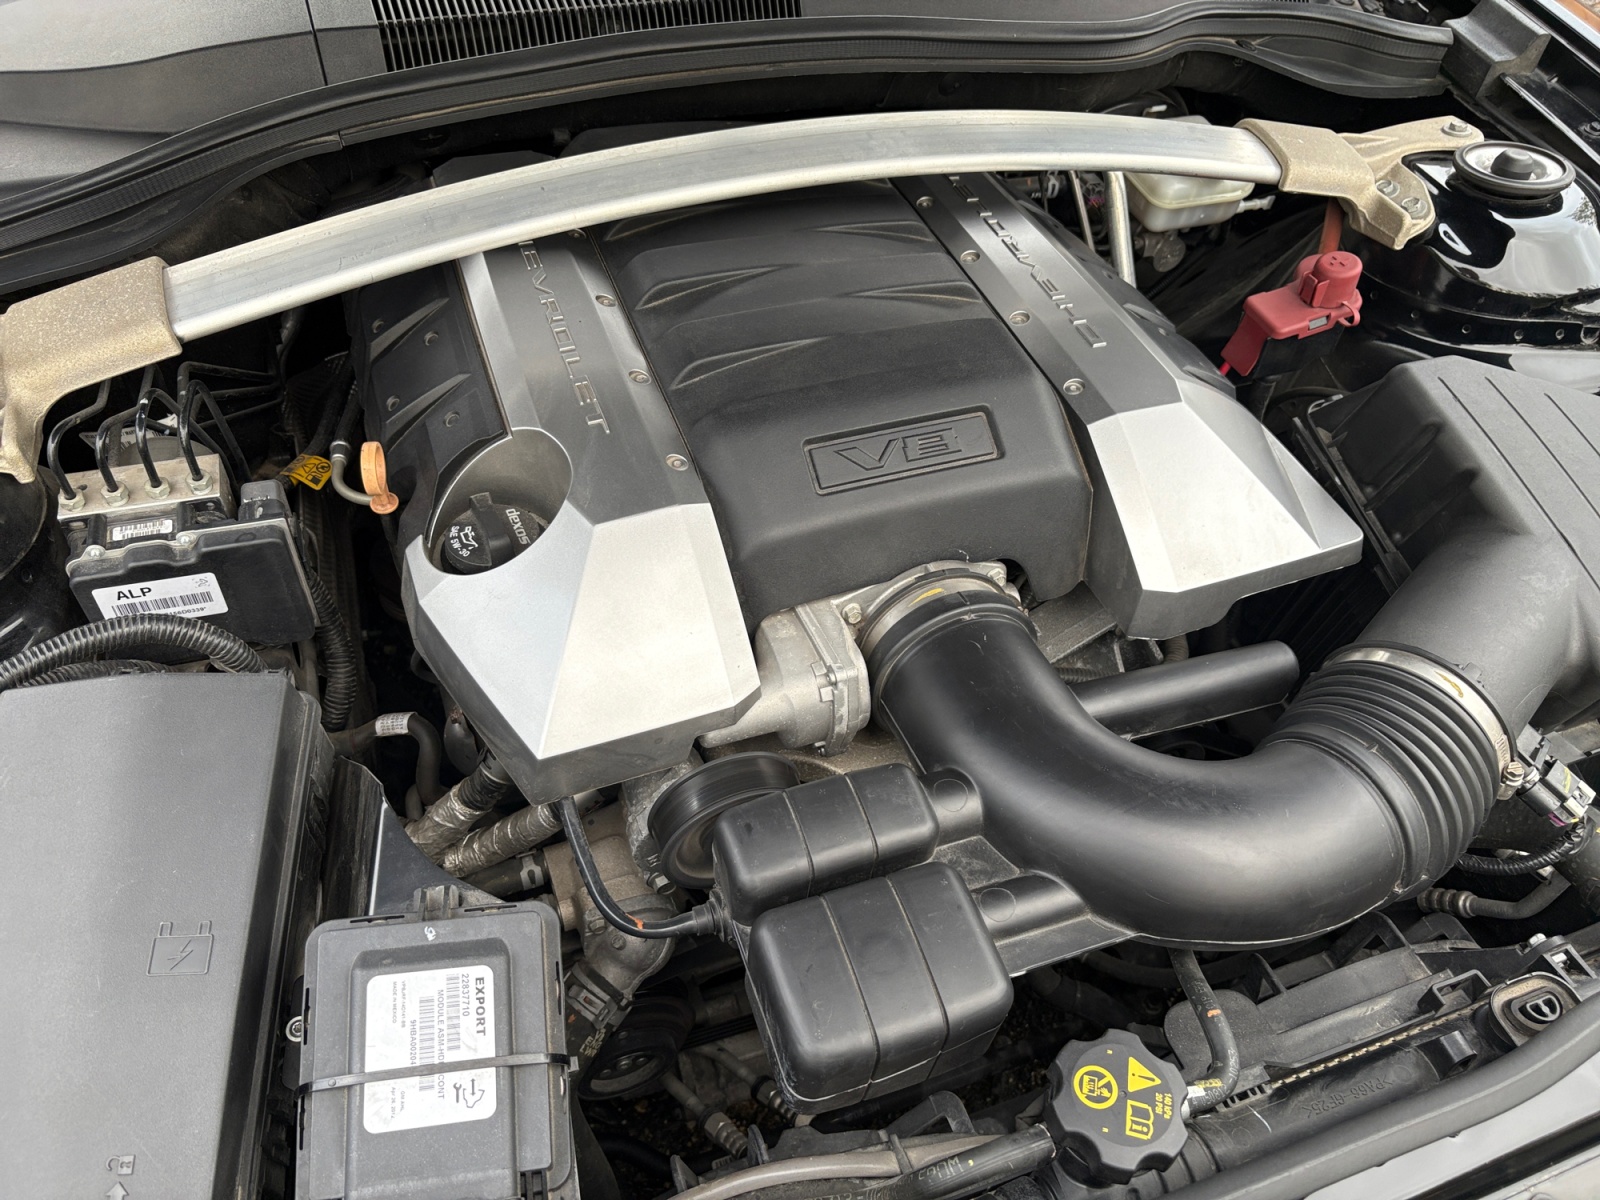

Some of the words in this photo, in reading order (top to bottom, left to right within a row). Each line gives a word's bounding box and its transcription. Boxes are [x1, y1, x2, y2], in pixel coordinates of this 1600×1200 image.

[518, 240, 610, 434] EVROLET
[833, 426, 963, 471] V8
[449, 525, 460, 538] SAE
[505, 508, 531, 545] dexos
[450, 538, 470, 557] 5W-30
[117, 586, 152, 601] ALP
[461, 973, 470, 1017] 22837710
[474, 976, 487, 1036] EXPORT
[437, 989, 445, 1026] MODULE
[437, 1074, 446, 1100] CONT
[1155, 1092, 1163, 1102] 20
[1155, 1102, 1163, 1114] PSI
[1163, 1092, 1173, 1105] 140
[1163, 1105, 1173, 1119] kPa
